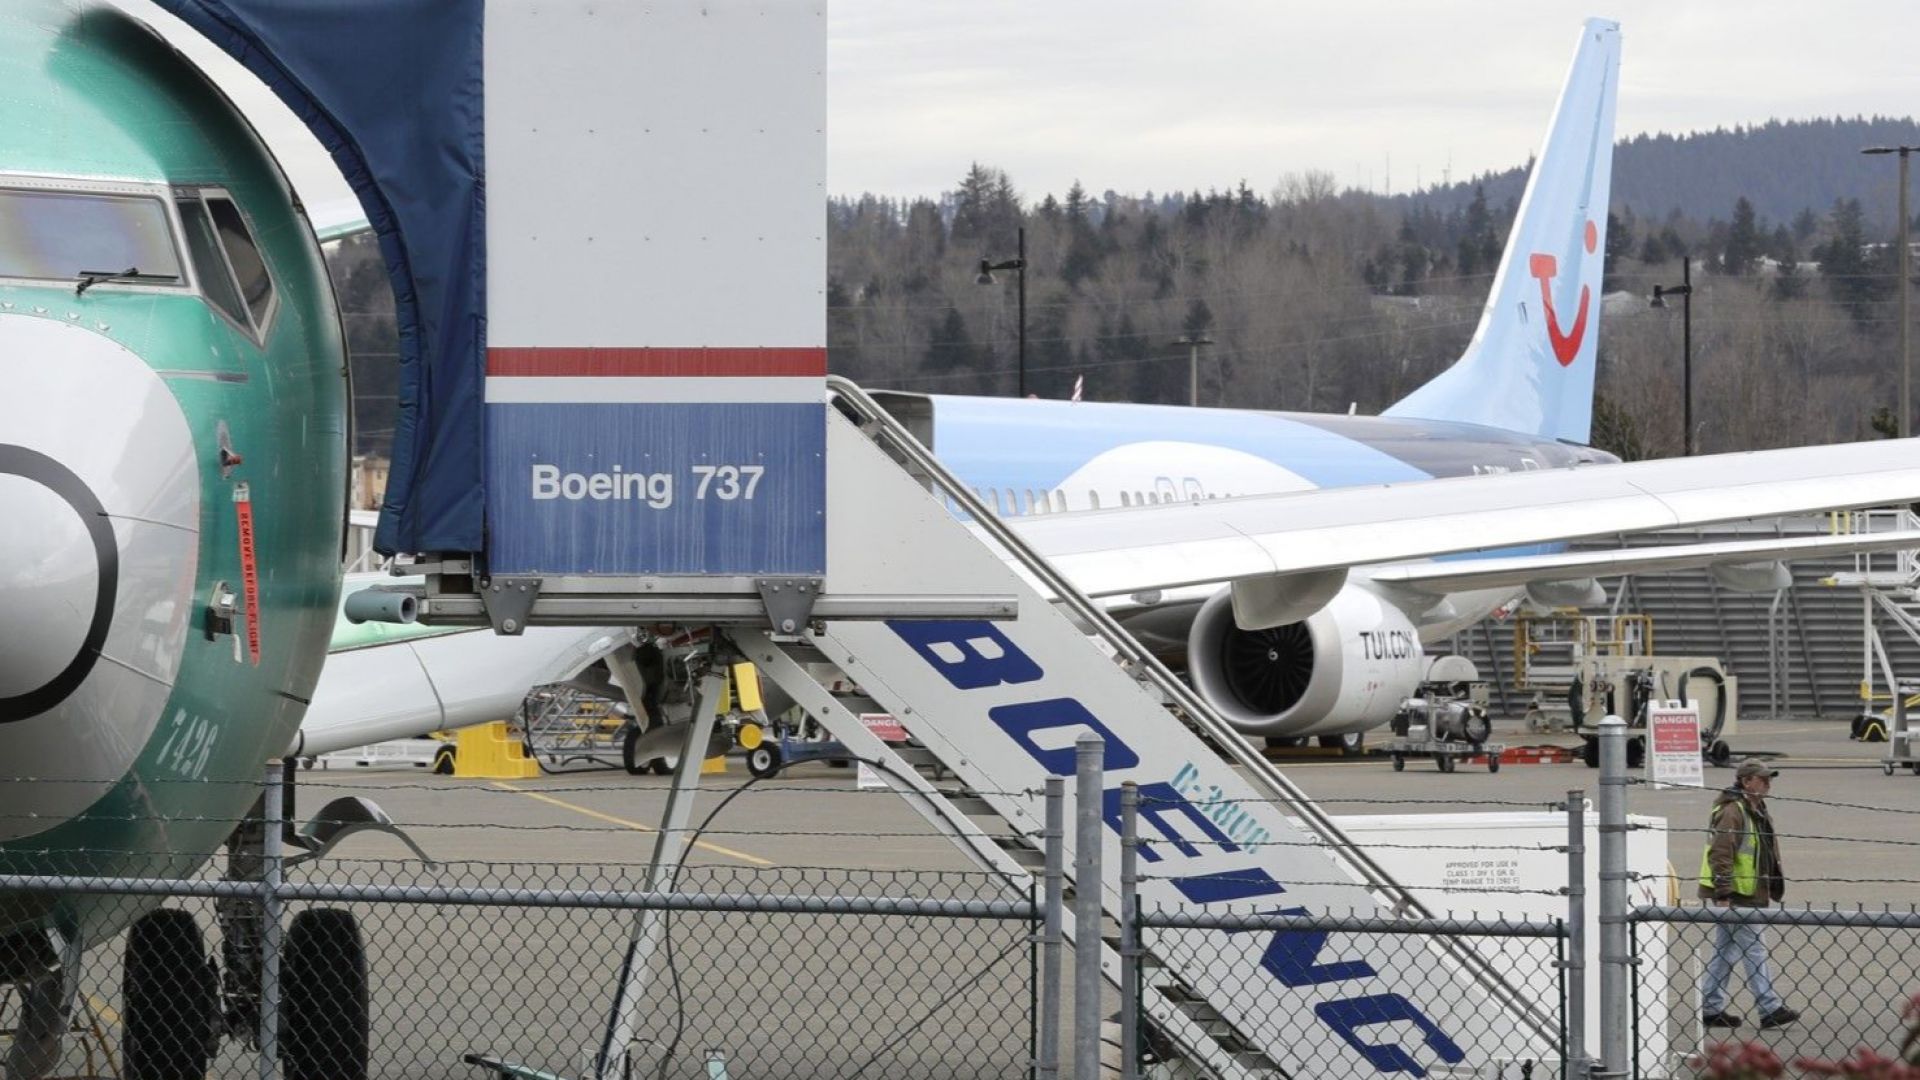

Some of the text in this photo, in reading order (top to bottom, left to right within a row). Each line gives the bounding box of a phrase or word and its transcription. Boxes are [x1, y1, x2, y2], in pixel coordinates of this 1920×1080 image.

[532, 464, 764, 509] Boeing 737
[240, 512, 259, 653] REMOVE BEFORE FLIGHT
[155, 707, 219, 780] 7426
[862, 718, 901, 728] DANGE
[1654, 715, 1697, 725] DANGER
[884, 620, 1466, 1078] BOEING
